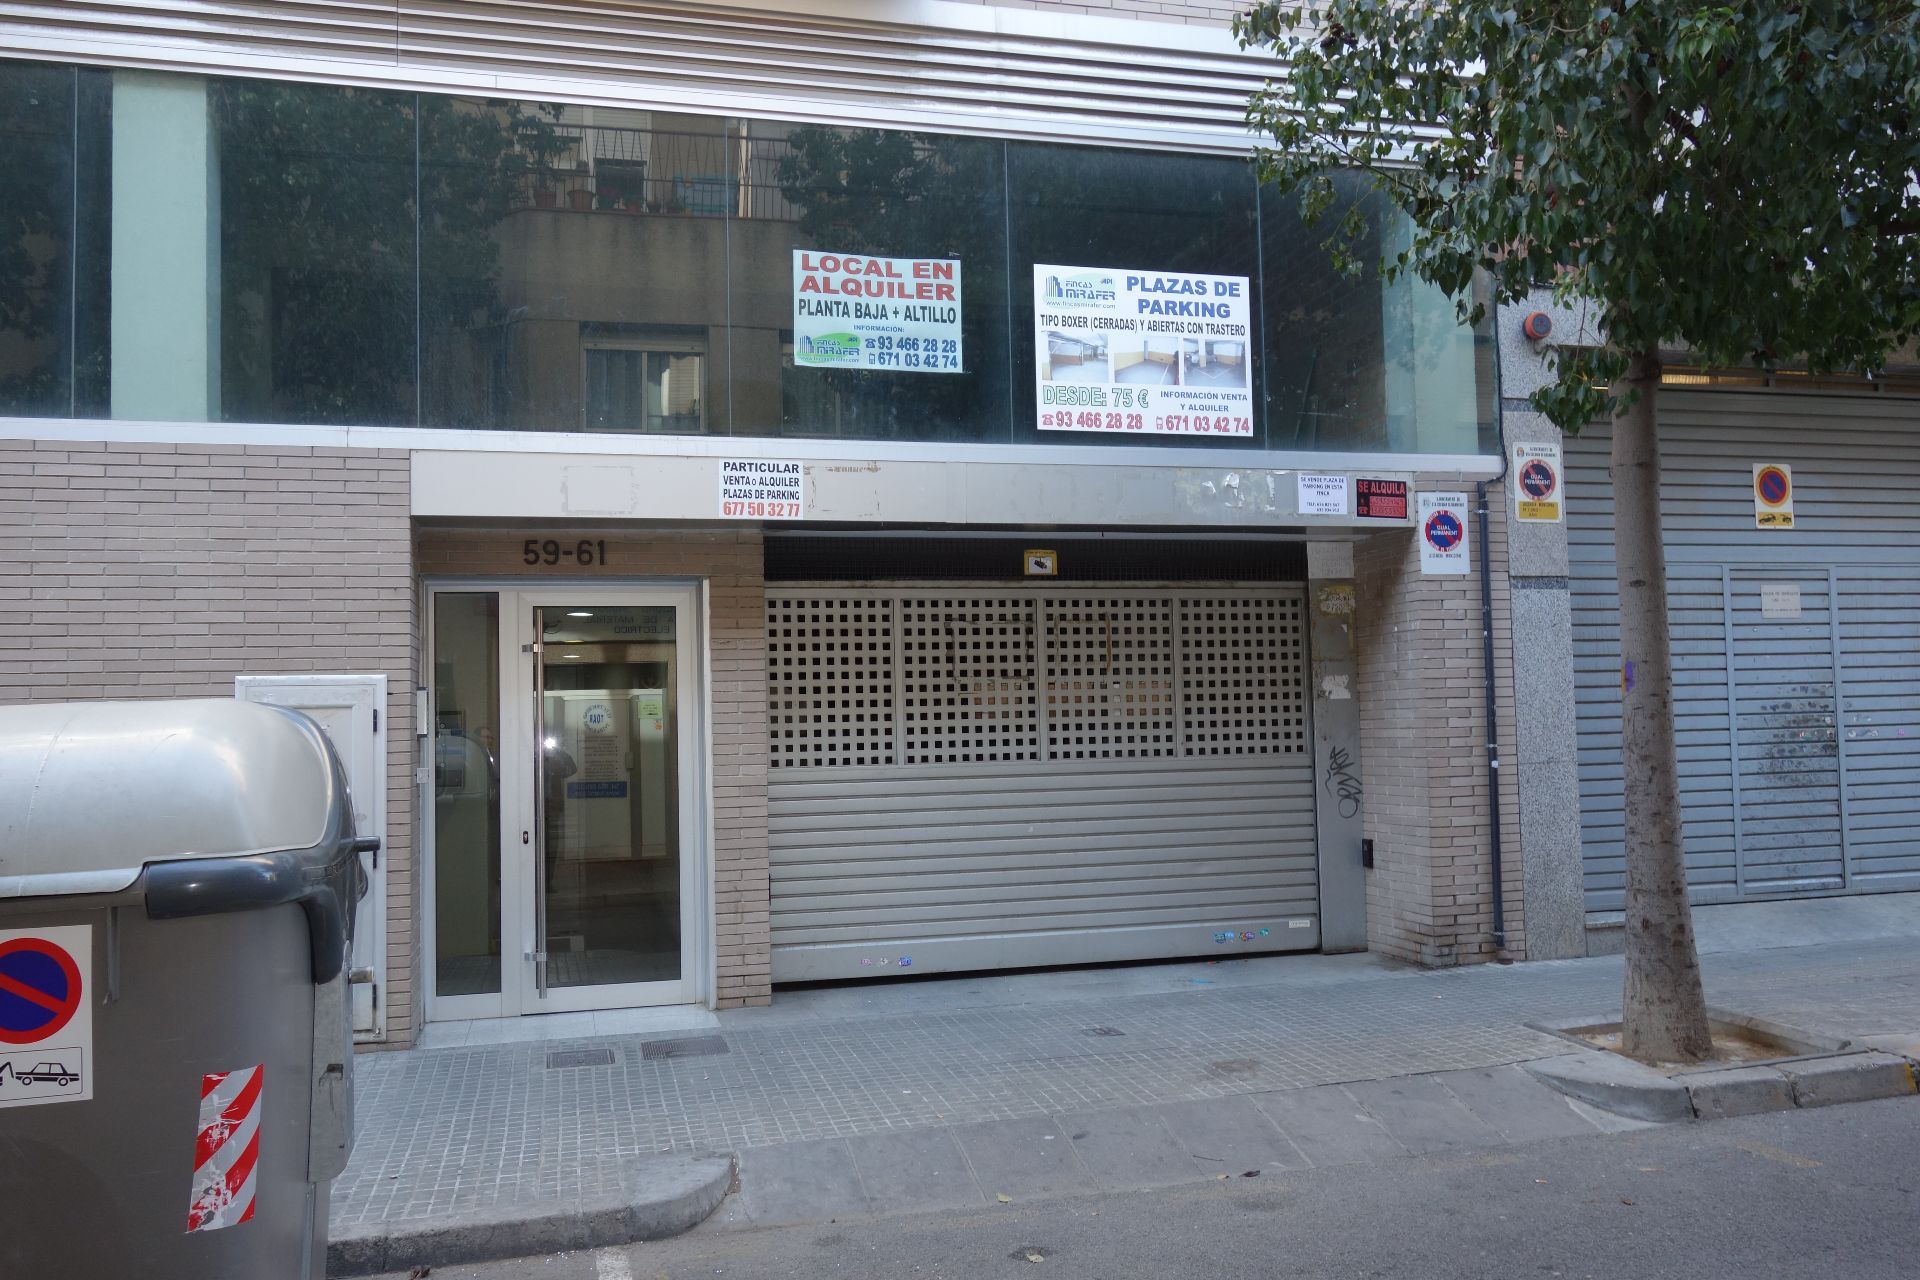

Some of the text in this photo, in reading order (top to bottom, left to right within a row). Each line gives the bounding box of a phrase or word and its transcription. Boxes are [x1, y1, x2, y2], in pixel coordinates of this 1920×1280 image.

[802, 254, 953, 279] LOCAL EN
[800, 276, 956, 301] ALQUILER
[1126, 276, 1240, 298] PLAZAS DE
[798, 298, 956, 324] PLANTA BAJA + ALTILLO
[1138, 299, 1230, 318] PARKING
[1040, 314, 1246, 336] TIPO BOXER (CERRADAS) Y ABIERTAS CON TRASTERO
[878, 336, 956, 353] 93 466 28 28
[878, 352, 958, 368] 671 03 42 74
[1043, 385, 1148, 408] DESDE: 75 €
[1188, 404, 1229, 412] ALQUILER
[1056, 411, 1142, 429] 93 466 28 28
[1166, 415, 1250, 433] 671 03 42 74
[724, 462, 799, 474] PARTICULAR
[724, 476, 750, 486] VENTA
[758, 478, 800, 488] ALQUILER
[1358, 480, 1406, 494] SE ALQUILA
[724, 489, 800, 500] PLAZAS DE PARKING
[724, 502, 800, 516] 677 50 32 77
[524, 540, 608, 566] 59-61
